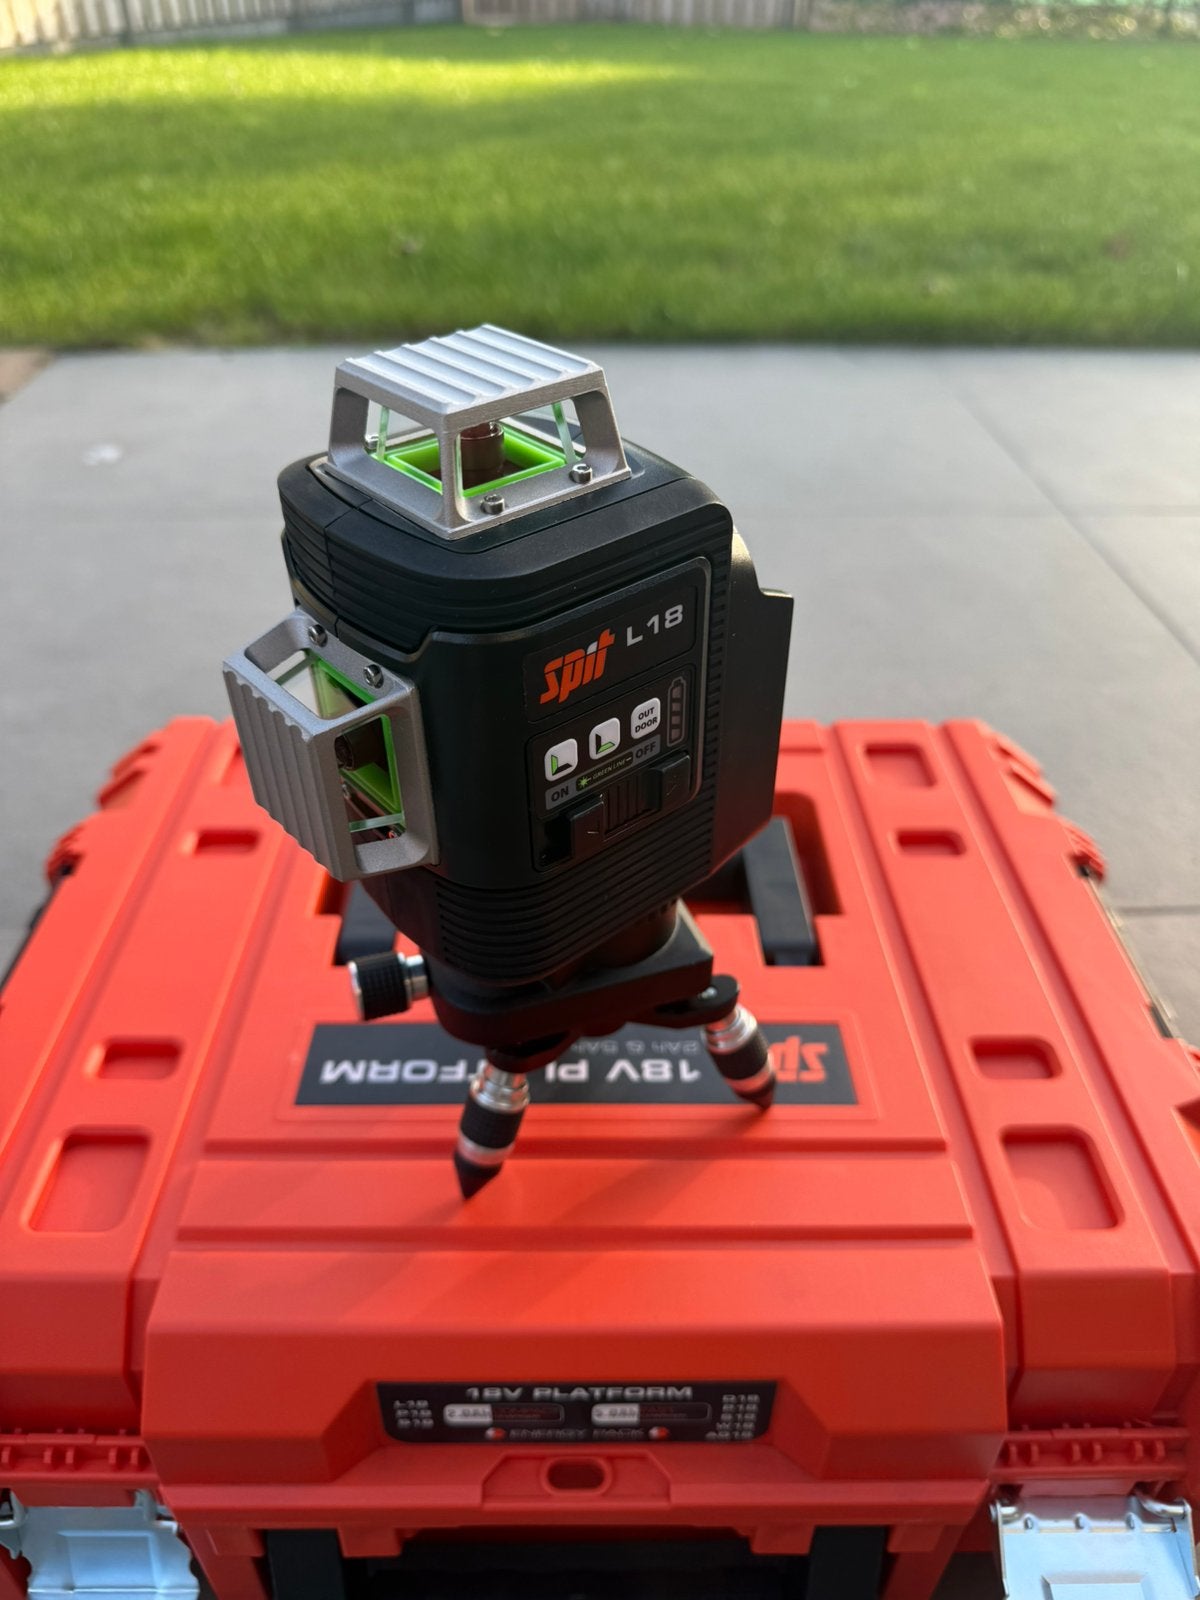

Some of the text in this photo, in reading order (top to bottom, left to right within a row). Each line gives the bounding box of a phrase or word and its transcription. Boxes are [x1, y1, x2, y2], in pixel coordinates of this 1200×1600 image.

[637, 706, 655, 721] OUT
[634, 716, 658, 733] DOOR
[635, 741, 657, 759] OFF
[550, 786, 569, 802] ON
[605, 1058, 701, 1083] 18V
[466, 1386, 693, 1401] 18V PLATFORM
